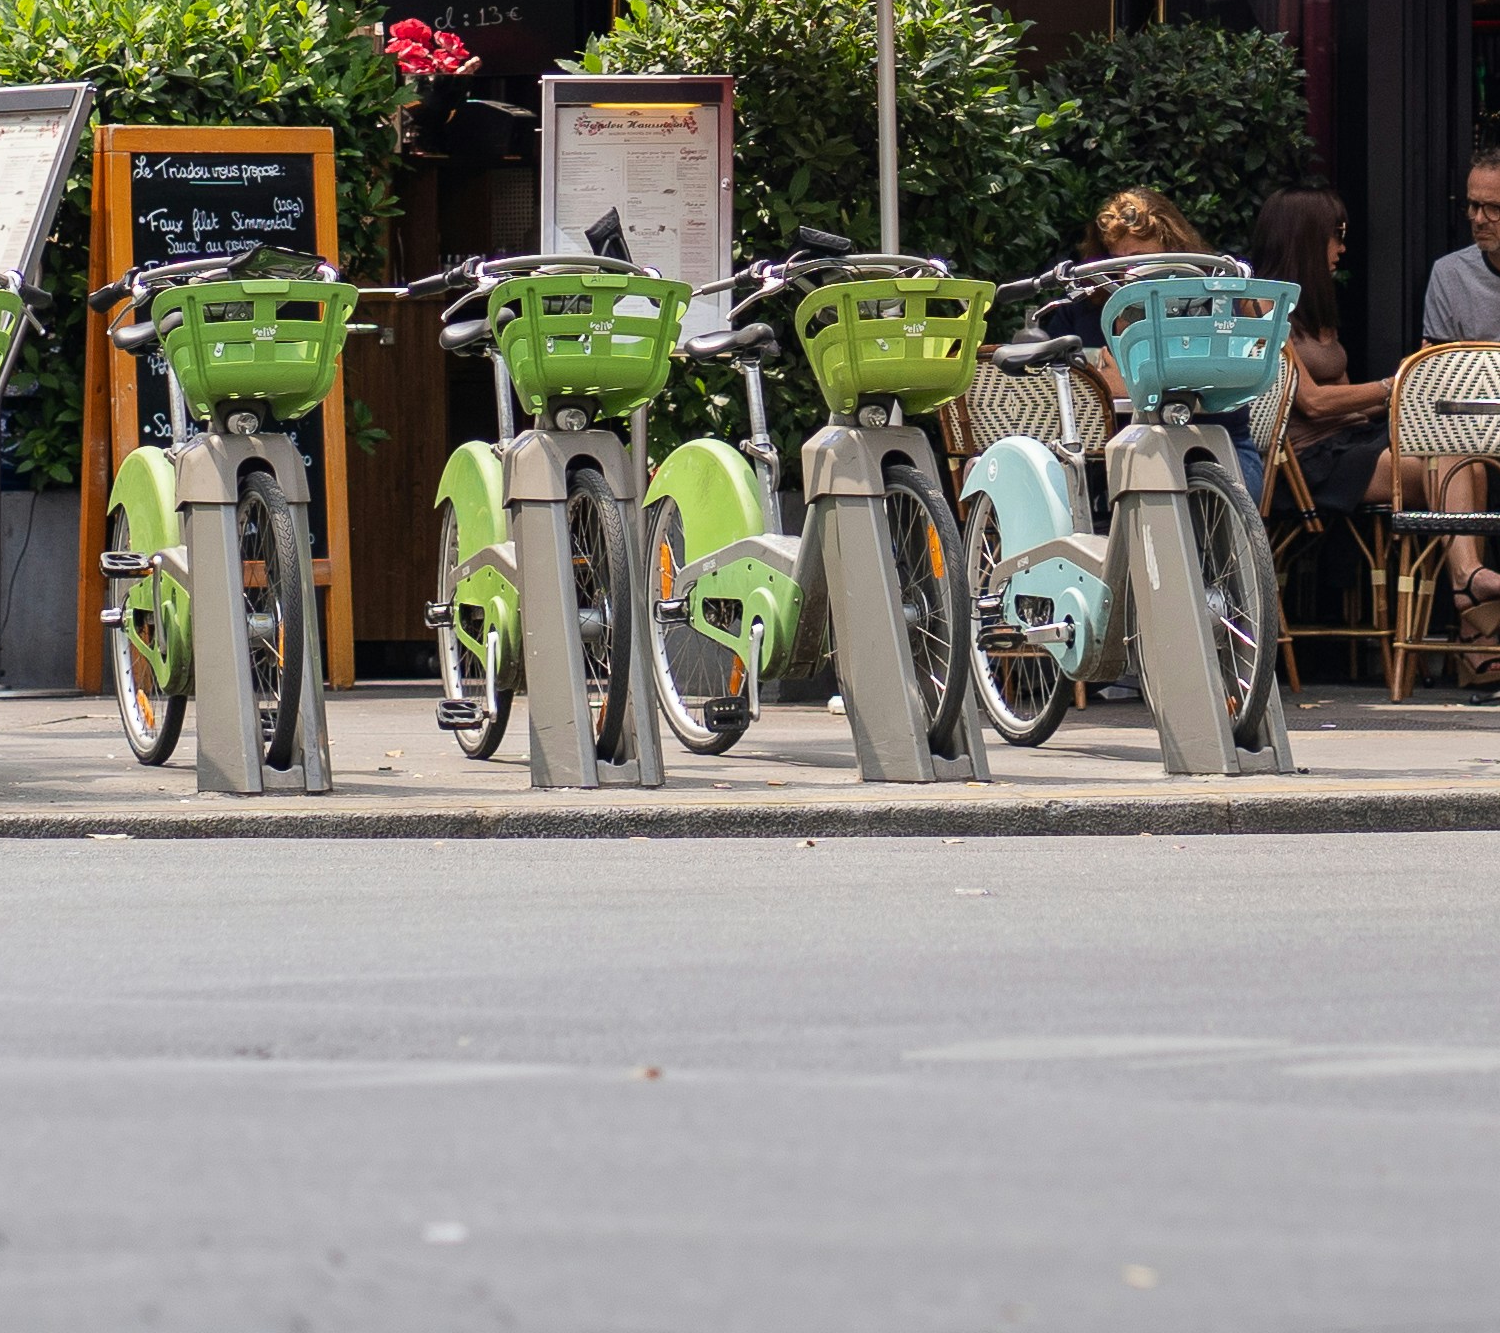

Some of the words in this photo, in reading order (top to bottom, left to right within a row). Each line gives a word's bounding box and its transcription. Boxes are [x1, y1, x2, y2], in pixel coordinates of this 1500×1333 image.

[133, 154, 154, 180] Le
[212, 164, 240, 179] vous
[147, 207, 184, 234] Faux
[192, 208, 220, 241] filet
[165, 233, 202, 255] Sauce
[205, 241, 225, 254] au
